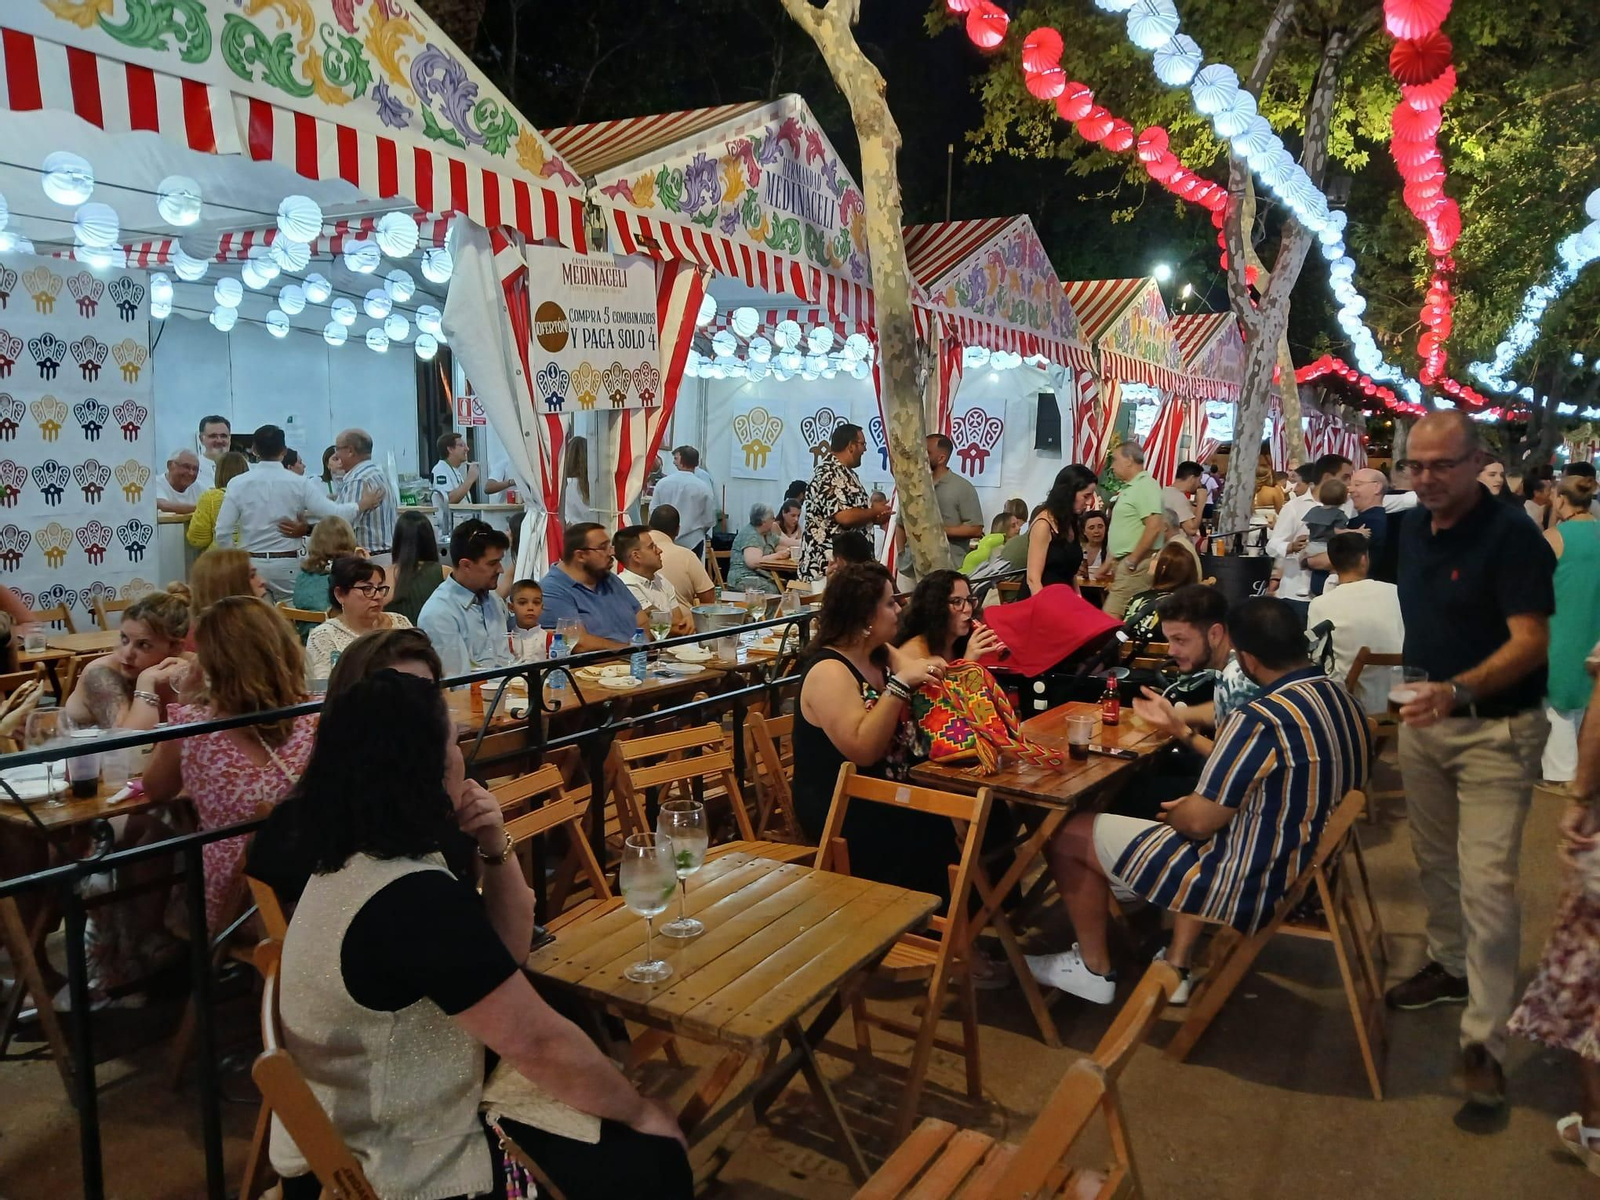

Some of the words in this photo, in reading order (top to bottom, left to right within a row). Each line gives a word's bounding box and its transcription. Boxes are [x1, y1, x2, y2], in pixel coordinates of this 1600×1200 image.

[764, 170, 835, 230] MEDINACELI
[562, 263, 628, 288] MEDINACELI
[568, 308, 602, 323] COMPRA
[603, 306, 610, 324] 5
[612, 311, 656, 325] COMBINADOS
[571, 327, 578, 349] Y
[582, 327, 615, 349] PAGA
[618, 328, 645, 350] SOLO
[648, 327, 656, 351] 4
